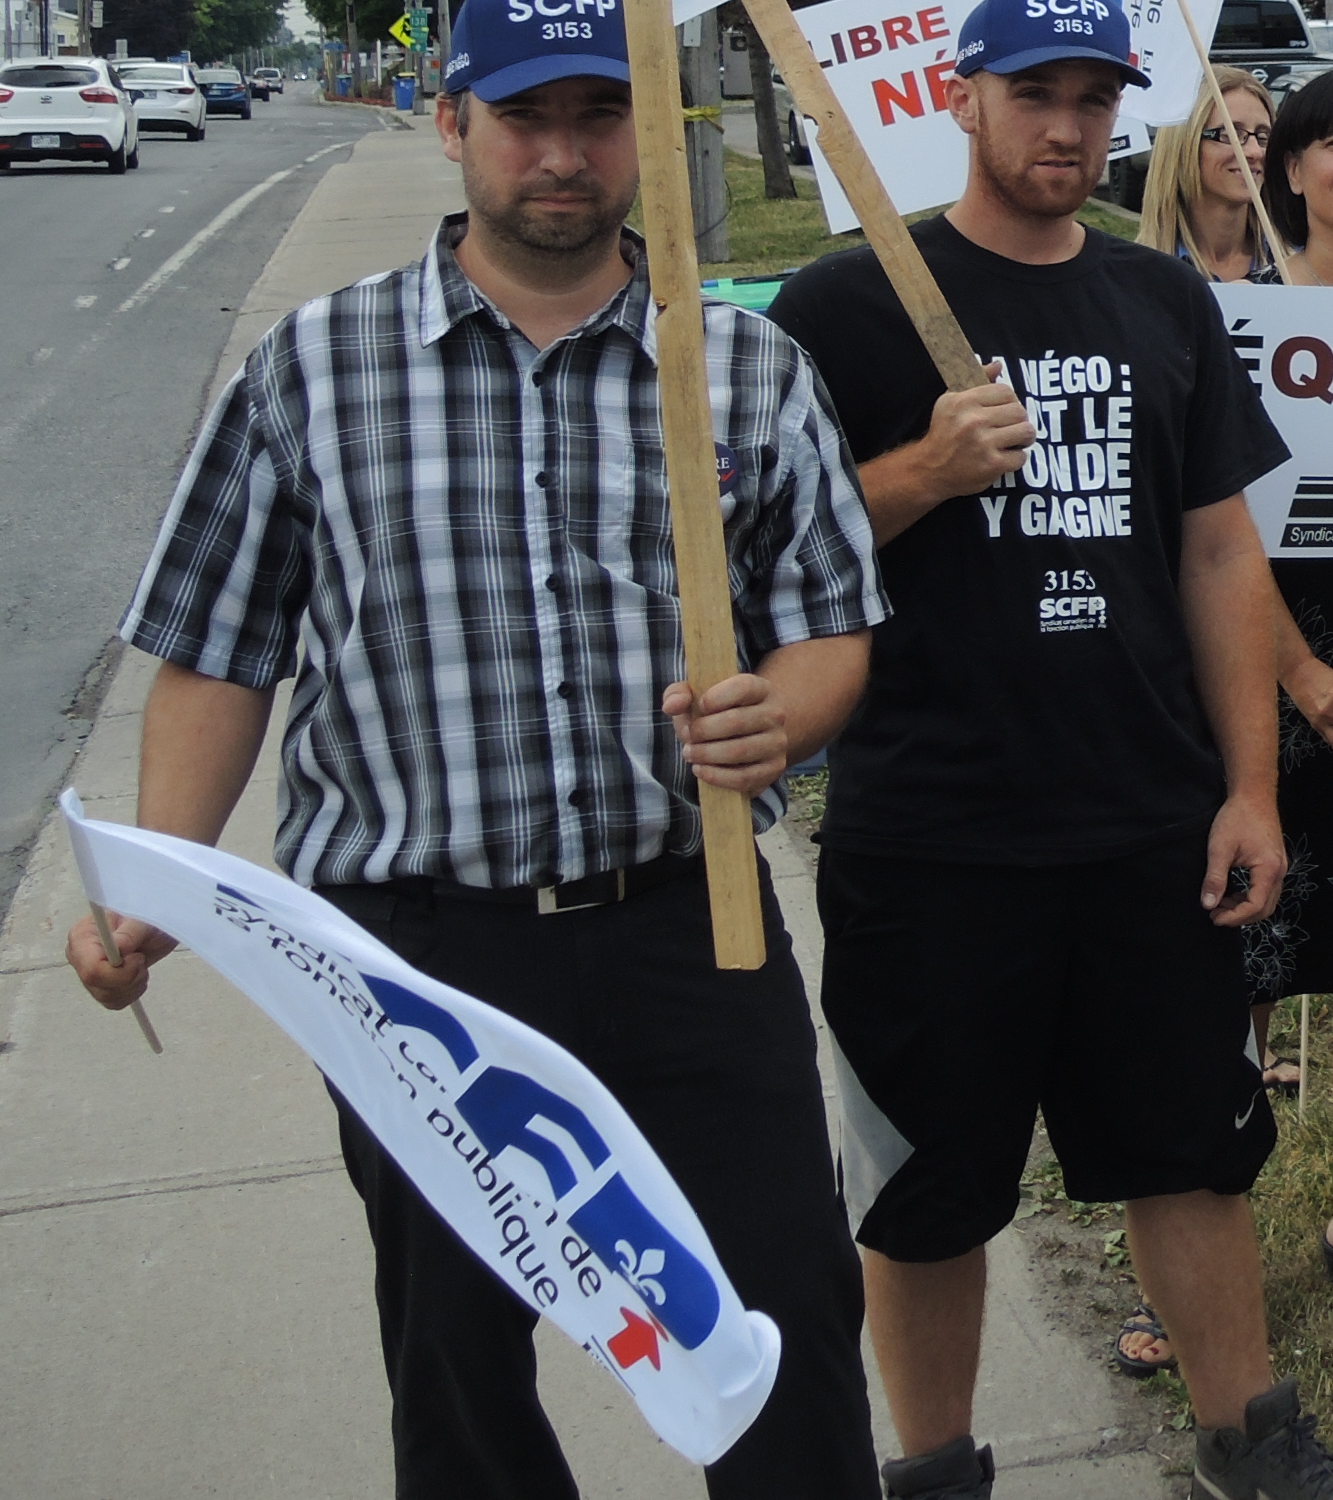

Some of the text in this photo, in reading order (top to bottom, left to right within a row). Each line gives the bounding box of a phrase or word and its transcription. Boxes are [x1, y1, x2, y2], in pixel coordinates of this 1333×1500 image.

[542, 21, 593, 40] 3153
[1053, 19, 1094, 35] 3153
[1020, 350, 1112, 397] NÉGO
[1082, 396, 1132, 440] LE
[979, 493, 1133, 539] Y GAGNE
[1044, 570, 1096, 592] 3153
[1040, 596, 1106, 618] SCFP
[426, 1107, 559, 1308] publique
[561, 1235, 602, 1298] de
